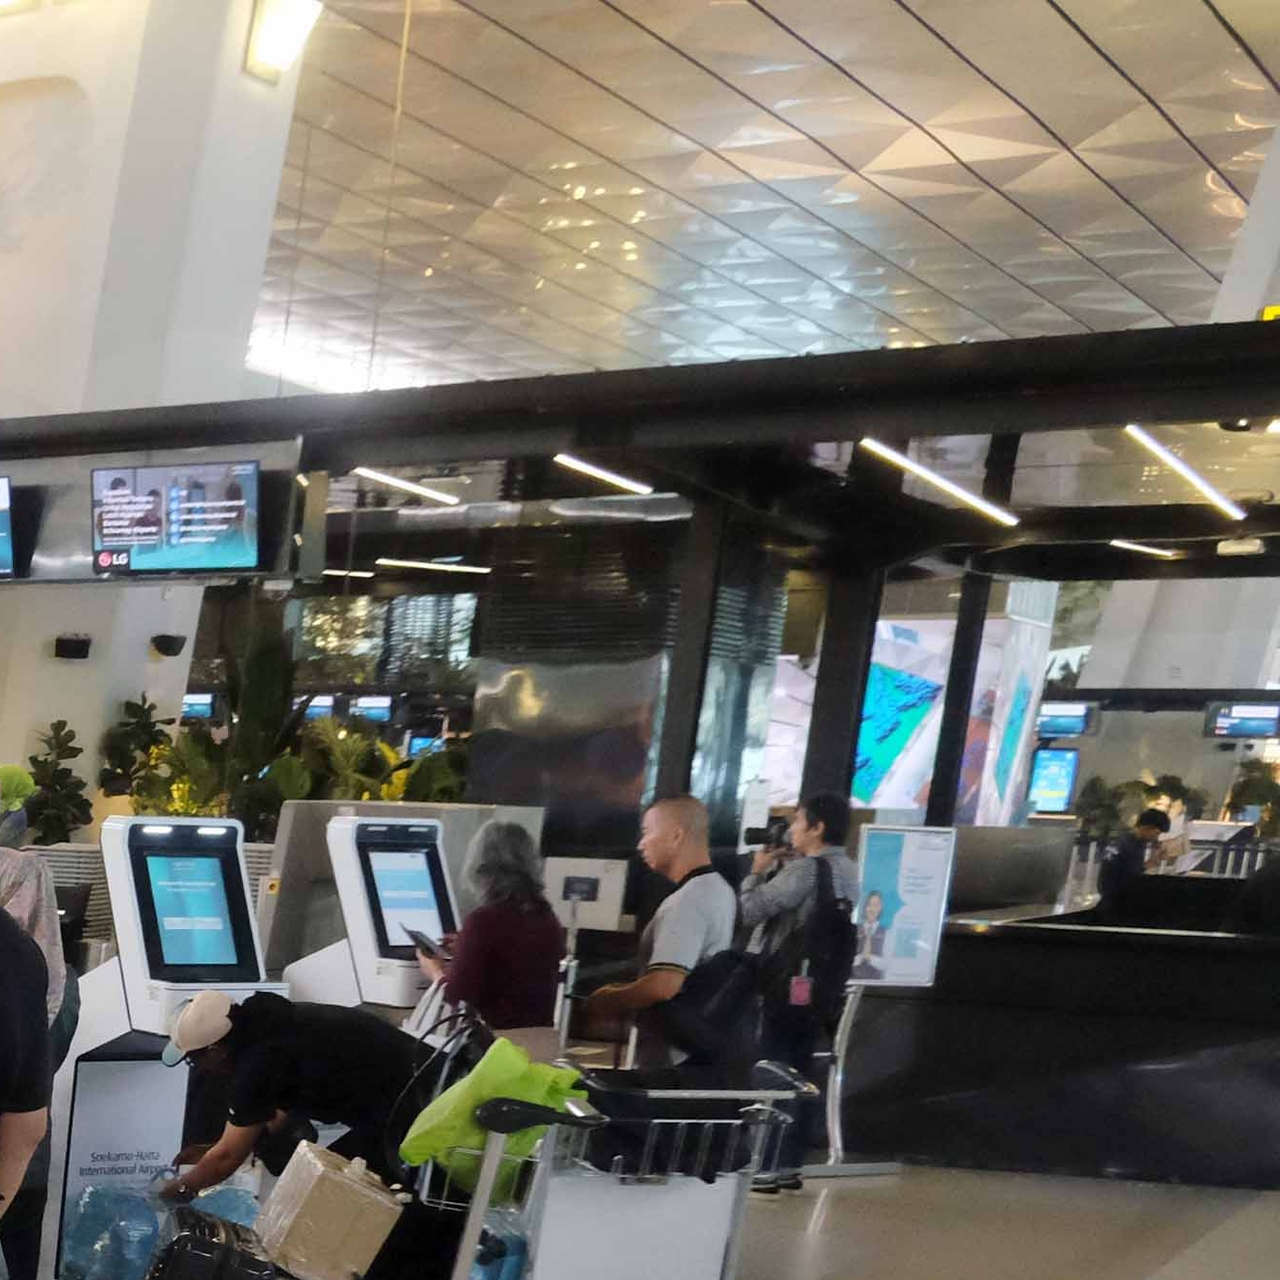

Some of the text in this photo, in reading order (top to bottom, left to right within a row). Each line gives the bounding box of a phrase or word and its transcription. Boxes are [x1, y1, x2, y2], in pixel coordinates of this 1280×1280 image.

[112, 553, 128, 565] LG
[91, 1151, 161, 1163] Soekarno-Hatta
[79, 1163, 137, 1177] International
